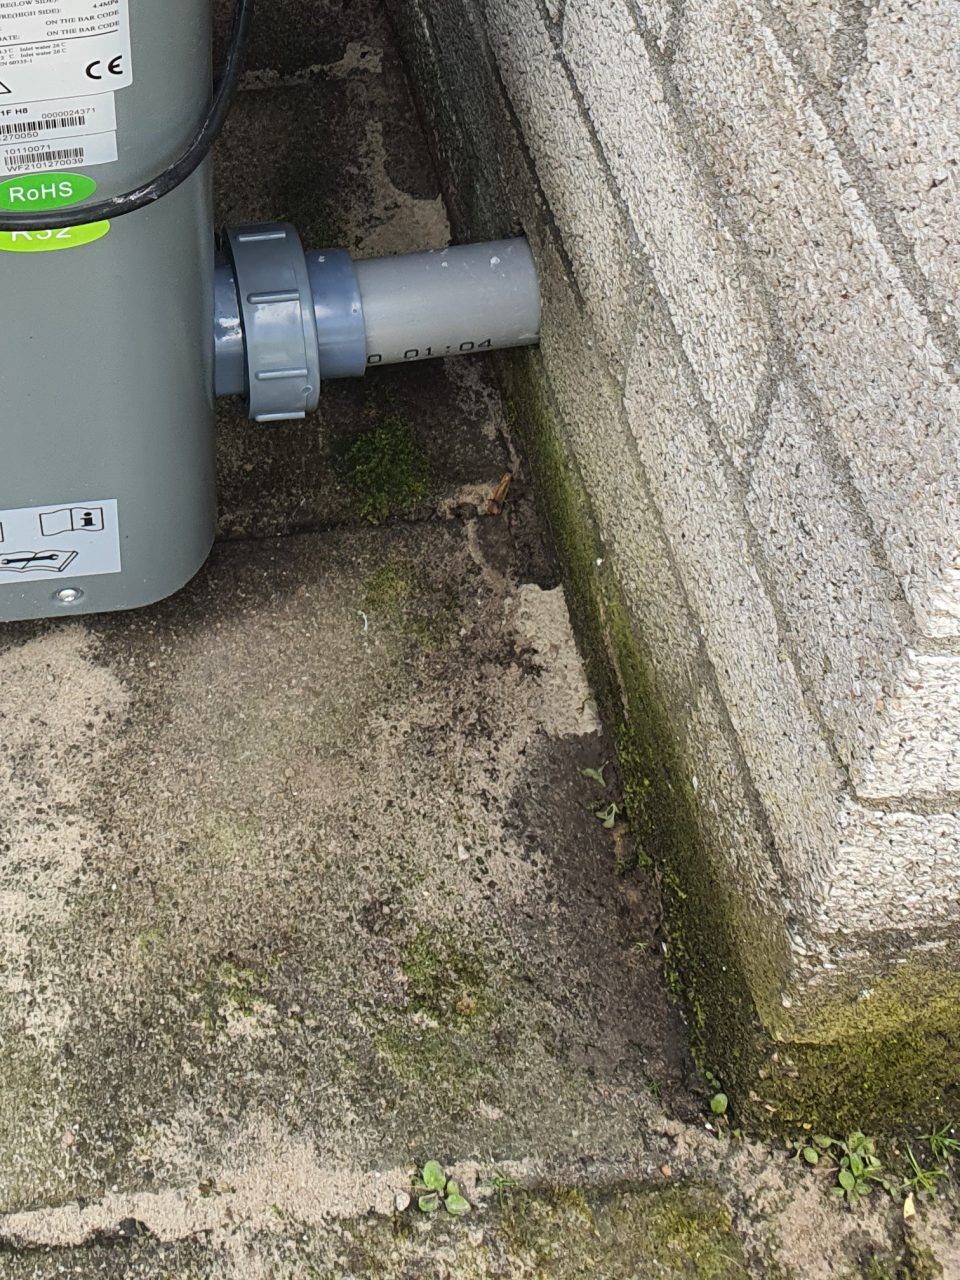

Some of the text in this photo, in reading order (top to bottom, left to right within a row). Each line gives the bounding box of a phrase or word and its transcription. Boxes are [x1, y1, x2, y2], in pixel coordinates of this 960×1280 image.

[78, 14, 95, 22] BAR
[97, 10, 119, 19] CODE
[79, 25, 96, 33] BAR
[98, 20, 120, 30] CODE
[15, 107, 28, 115] H8
[5, 144, 51, 155] 10110071
[9, 181, 73, 203] RoHS
